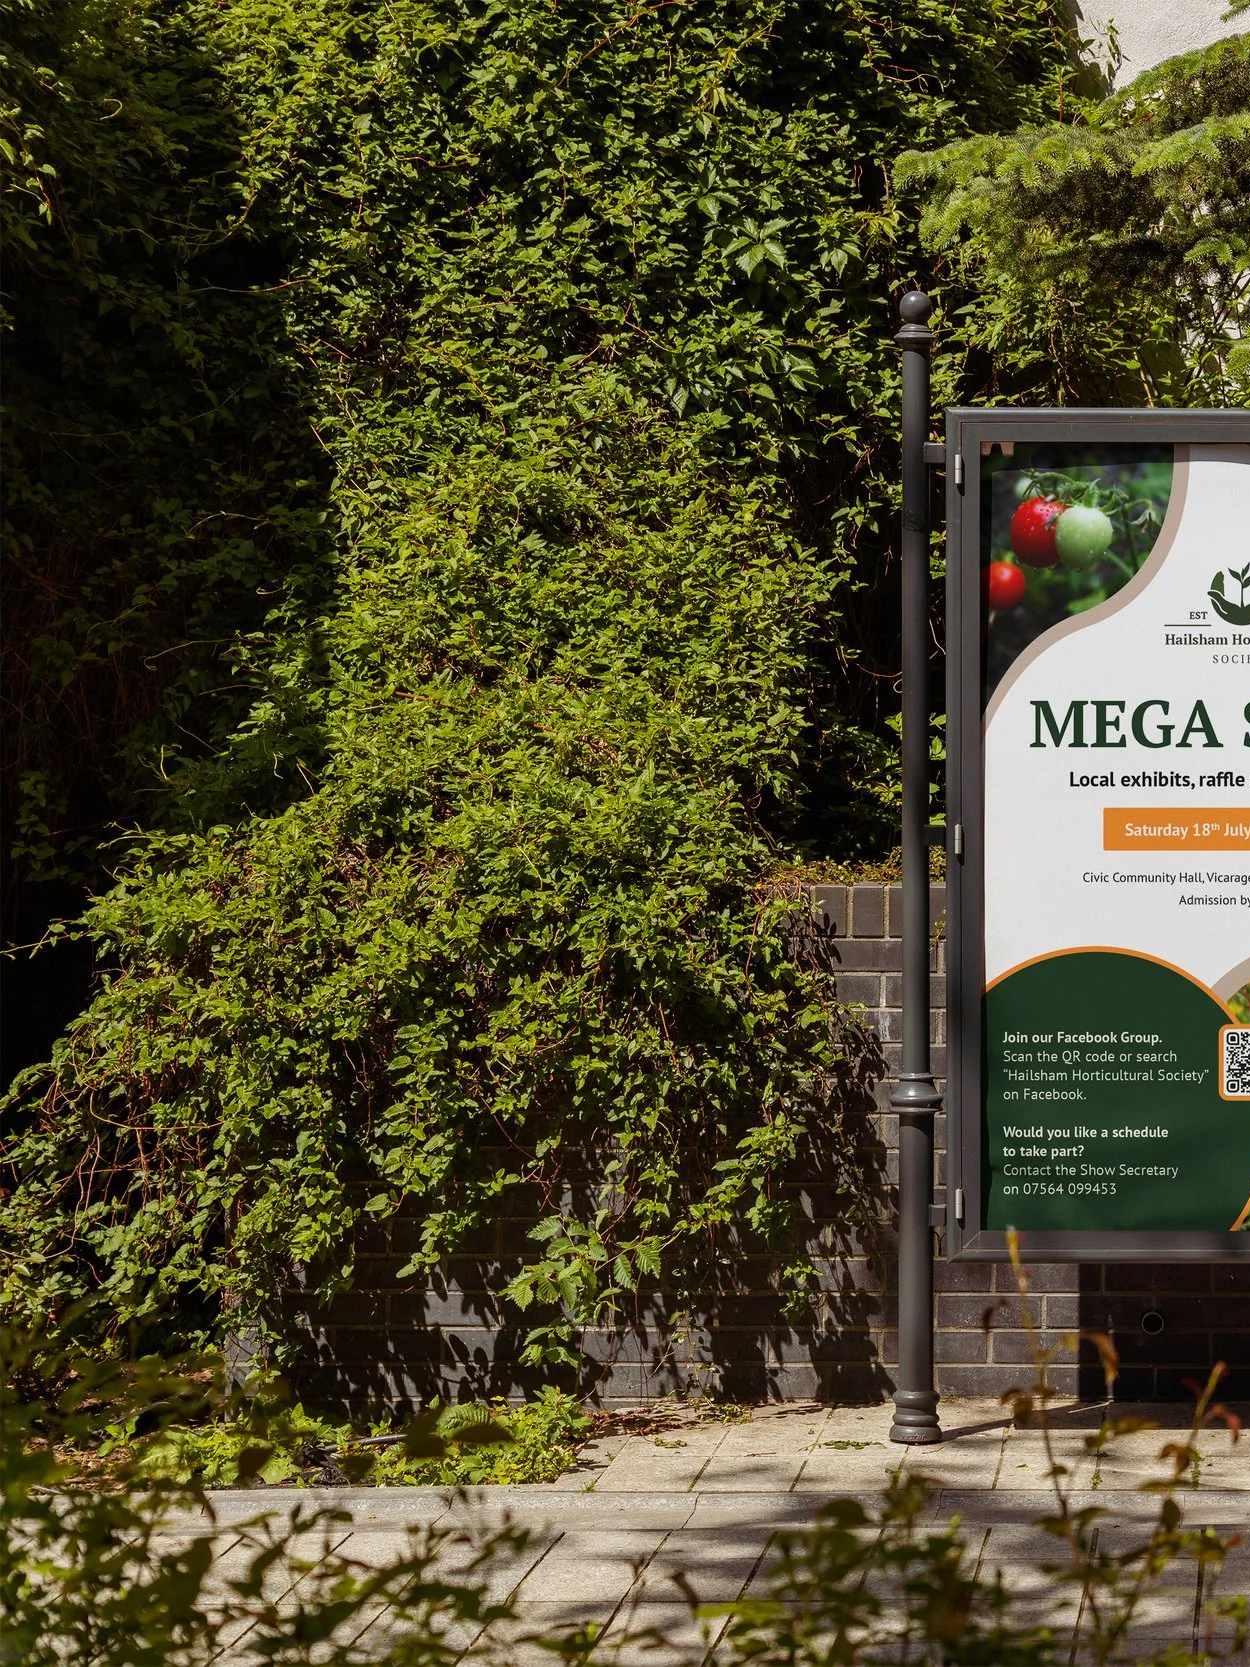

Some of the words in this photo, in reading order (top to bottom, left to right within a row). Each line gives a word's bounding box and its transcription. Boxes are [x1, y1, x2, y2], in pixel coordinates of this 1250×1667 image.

[1190, 611, 1208, 620] EST
[1165, 633, 1228, 646] Hailsham
[1030, 700, 1224, 748] MEGA
[1070, 771, 1115, 788] Local
[1121, 770, 1195, 791] exhibits,
[1200, 771, 1245, 788] raffle
[1125, 822, 1188, 840] Saturday
[1193, 822, 1220, 837] 18th
[1083, 871, 1109, 883] Civic
[1113, 871, 1176, 886] Community
[1180, 871, 1204, 885] Hall,
[1179, 894, 1236, 906] Admission
[1003, 1031, 1028, 1044] Join
[1032, 1034, 1053, 1044] our
[1058, 1031, 1117, 1044] Facebook
[1121, 1031, 1162, 1047] Group.
[1004, 1050, 1032, 1063] Scan
[1037, 1050, 1058, 1063] the
[1062, 1050, 1080, 1065] QR
[1086, 1050, 1114, 1063] code
[1120, 1053, 1132, 1063] or
[1137, 1050, 1176, 1063] search
[1073, 1069, 1153, 1082] Horticultural
[1004, 1090, 1018, 1101] on
[1024, 1087, 1086, 1100] Facebook.
[1003, 1125, 1043, 1138] Would
[1047, 1128, 1070, 1141] you
[1075, 1125, 1097, 1138] like
[1101, 1128, 1108, 1138] a
[1113, 1125, 1168, 1138] schedule
[1003, 1146, 1015, 1157] to
[1020, 1144, 1047, 1157] take
[1051, 1144, 1084, 1160] part?
[1004, 1163, 1051, 1176] Contact
[1055, 1163, 1076, 1176] the
[1081, 1163, 1115, 1176] Show
[1119, 1163, 1178, 1179] Secretary
[1004, 1185, 1018, 1195] on
[1023, 1182, 1064, 1195] 07564
[1068, 1182, 1116, 1195] 099453
